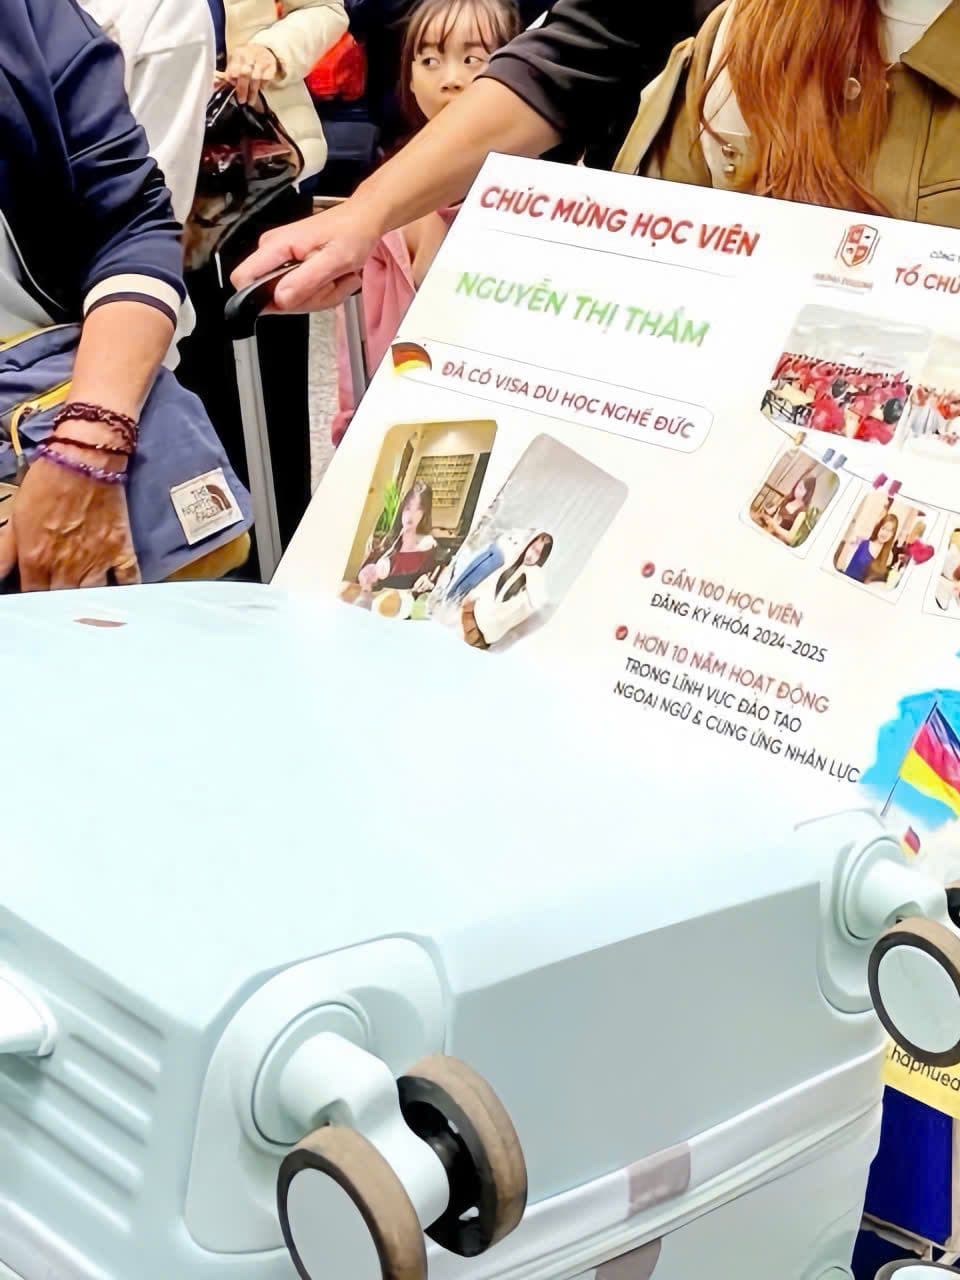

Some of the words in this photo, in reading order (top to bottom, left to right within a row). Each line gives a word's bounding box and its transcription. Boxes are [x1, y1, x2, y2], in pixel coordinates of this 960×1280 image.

[480, 186, 549, 218] CHÚC
[551, 196, 628, 232] MỪNG
[631, 212, 693, 248] HỌC
[700, 223, 761, 257] VIÊN
[573, 295, 620, 335] THỊ
[467, 367, 492, 385] CÓ
[494, 374, 529, 397] VISA
[533, 385, 559, 403] DU
[561, 392, 600, 414] HỌC
[699, 579, 726, 602] 100
[726, 589, 765, 615] HỌC
[767, 601, 804, 628] VIÊN
[752, 627, 829, 663] 2024-2025
[625, 657, 671, 685] TRONG
[774, 710, 802, 733] TẠO
[672, 645, 689, 665] 10
[729, 665, 776, 697] HOẠT
[613, 681, 659, 711] NGOẠI
[691, 711, 703, 726] &
[705, 715, 748, 742] CUNG
